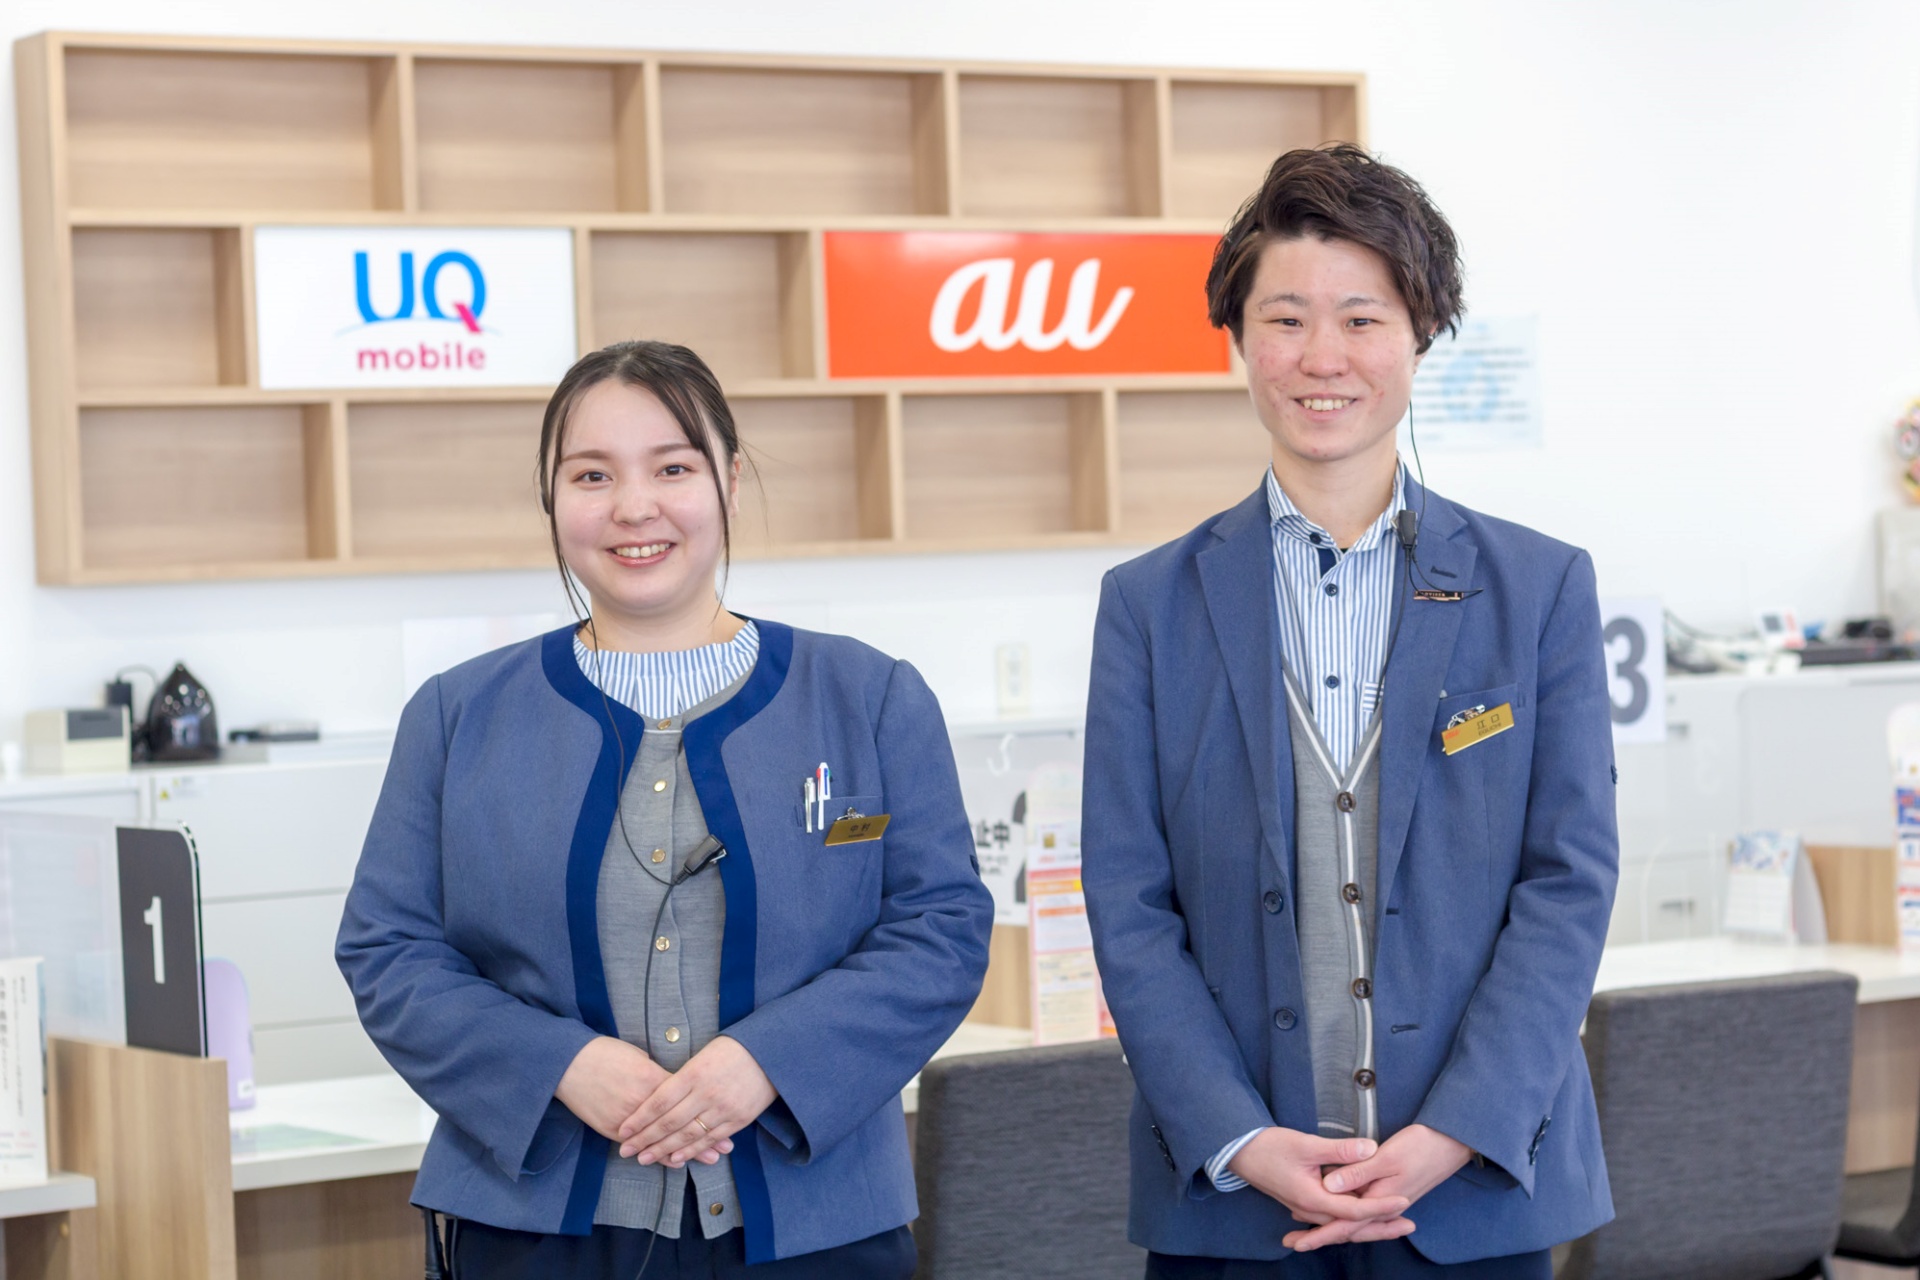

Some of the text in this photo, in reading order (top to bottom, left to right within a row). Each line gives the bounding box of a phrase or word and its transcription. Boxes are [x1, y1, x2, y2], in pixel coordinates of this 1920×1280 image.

[354, 250, 487, 334] UQ
[929, 257, 1136, 353] au
[357, 342, 486, 371] mobile
[1602, 615, 1649, 726] 3
[143, 895, 166, 985] 1
